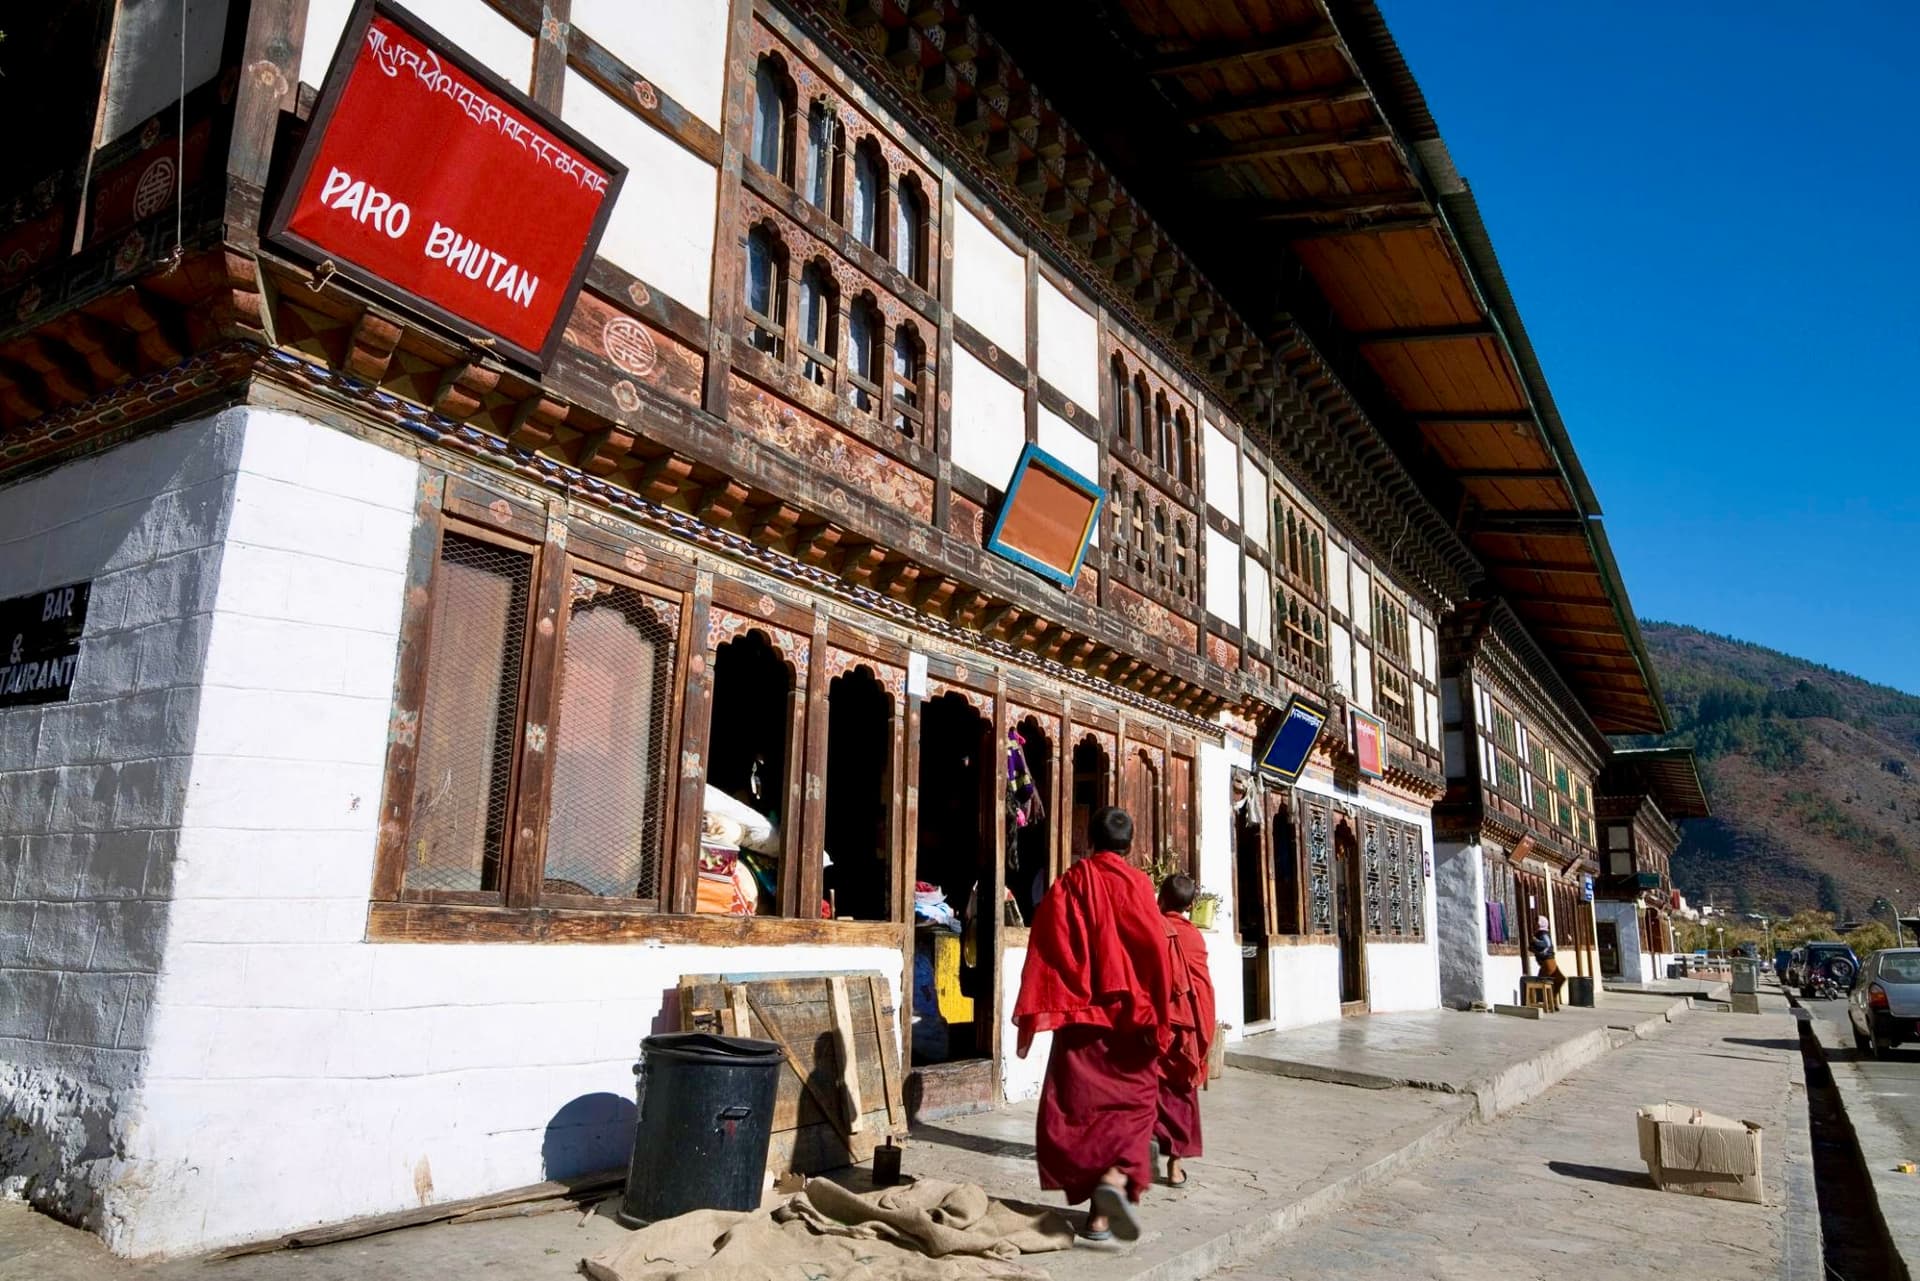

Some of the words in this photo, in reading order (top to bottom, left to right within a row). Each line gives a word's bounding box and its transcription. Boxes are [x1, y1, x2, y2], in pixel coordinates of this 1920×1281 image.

[320, 167, 411, 238] PARO
[425, 222, 539, 308] BHUTAN
[42, 587, 74, 621] BAR
[10, 633, 24, 664] &
